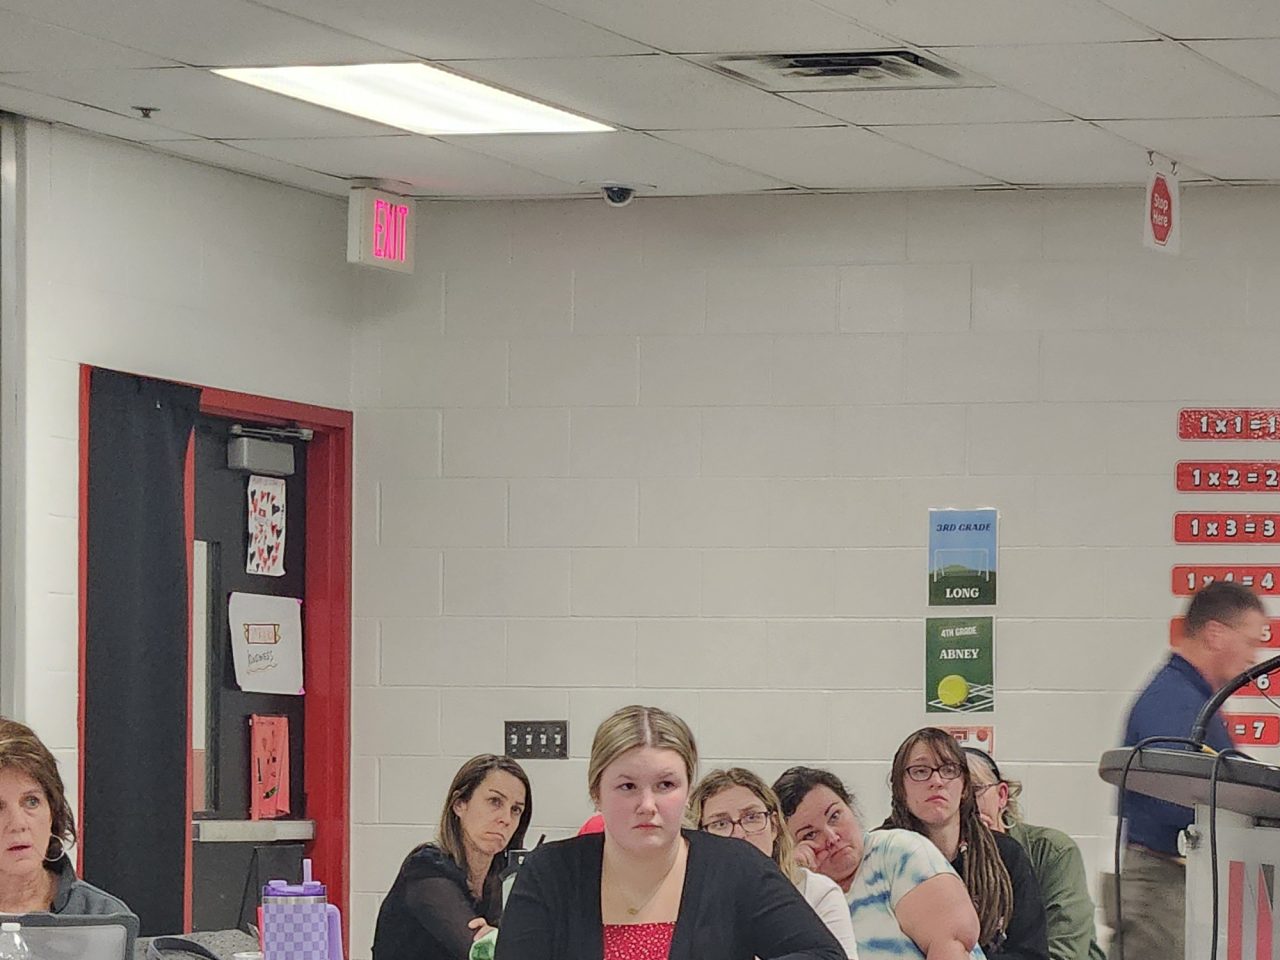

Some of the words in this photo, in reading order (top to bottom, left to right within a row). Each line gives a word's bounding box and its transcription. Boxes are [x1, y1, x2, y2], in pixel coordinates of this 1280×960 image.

[1153, 193, 1169, 213] Stop
[1152, 209, 1168, 227] Here
[374, 199, 408, 262] EXIT
[1193, 469, 1201, 485] 1
[1208, 472, 1220, 486] x
[1227, 469, 1240, 486] 2
[1265, 469, 1278, 486] 2
[936, 523, 957, 532] 3RD
[958, 523, 991, 532] GRADE
[1191, 518, 1199, 535] 1
[1206, 522, 1218, 536] x
[1225, 519, 1237, 536] 3
[1263, 519, 1275, 536] 3
[945, 588, 979, 598] LONG
[941, 628, 954, 638] 4TH
[939, 649, 979, 659] ABNEY
